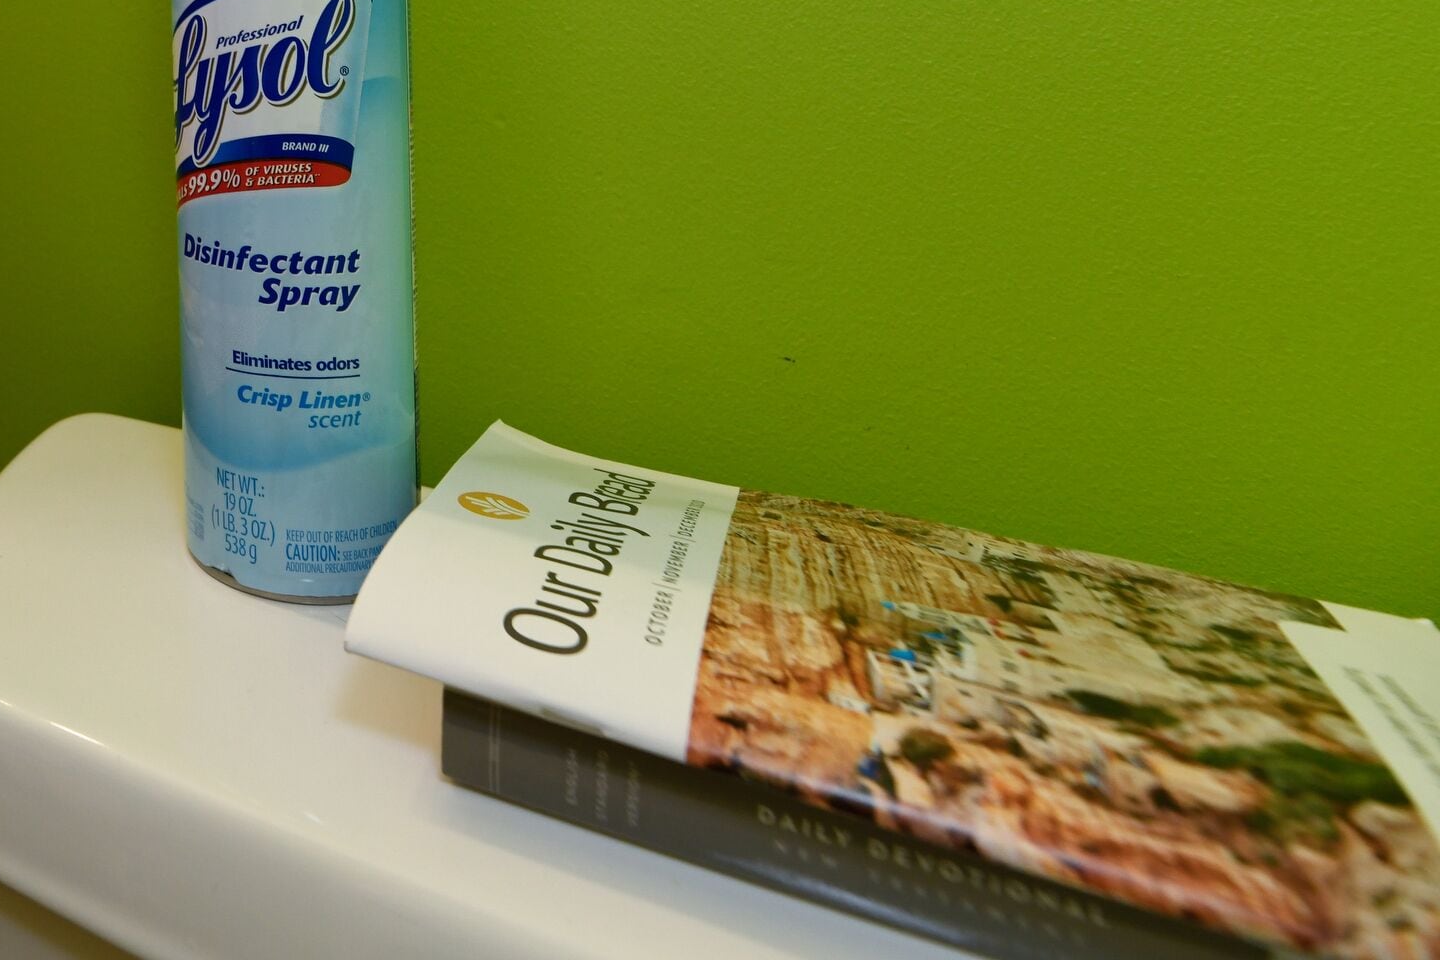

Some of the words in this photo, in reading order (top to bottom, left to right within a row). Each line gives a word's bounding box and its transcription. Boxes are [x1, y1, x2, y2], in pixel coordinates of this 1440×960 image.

[216, 15, 304, 49] Professional
[282, 141, 317, 152] BRAND
[318, 143, 330, 153] III
[188, 168, 241, 196] 99.9%
[245, 166, 260, 177] OF
[263, 162, 312, 175] VIRUSES
[245, 177, 254, 187] &
[184, 233, 360, 274] Disinfectant
[258, 278, 361, 312] Spray
[232, 349, 312, 371] Eliminates
[315, 357, 360, 371] odors
[237, 384, 293, 412] Crisp
[307, 410, 362, 429] scent
[216, 467, 236, 491] NET
[568, 468, 657, 517] Bread
[223, 492, 236, 511] 19
[238, 496, 257, 517] OZ.
[211, 503, 220, 530] (1
[222, 511, 238, 534] LB.
[240, 517, 248, 536] 3
[251, 519, 276, 547] OZ.)
[286, 529, 305, 541] KEEP
[306, 530, 322, 543] OUT
[324, 531, 333, 543] OF
[335, 529, 359, 542] REACH
[360, 527, 369, 540] OF
[225, 533, 247, 557] 538
[248, 544, 258, 565] g
[286, 543, 341, 562] CAUTION:
[342, 550, 353, 562] SEE
[353, 547, 369, 560] BACK
[533, 513, 651, 576] Daily
[286, 561, 324, 574] ADDITIONAL
[644, 590, 675, 647] OCTOBER
[661, 541, 690, 585] NOVEMBER
[677, 507, 700, 538] DECEMBER
[503, 571, 602, 655] Our
[757, 805, 850, 848] DAILY
[868, 838, 1112, 929] DEVOTIONAL
